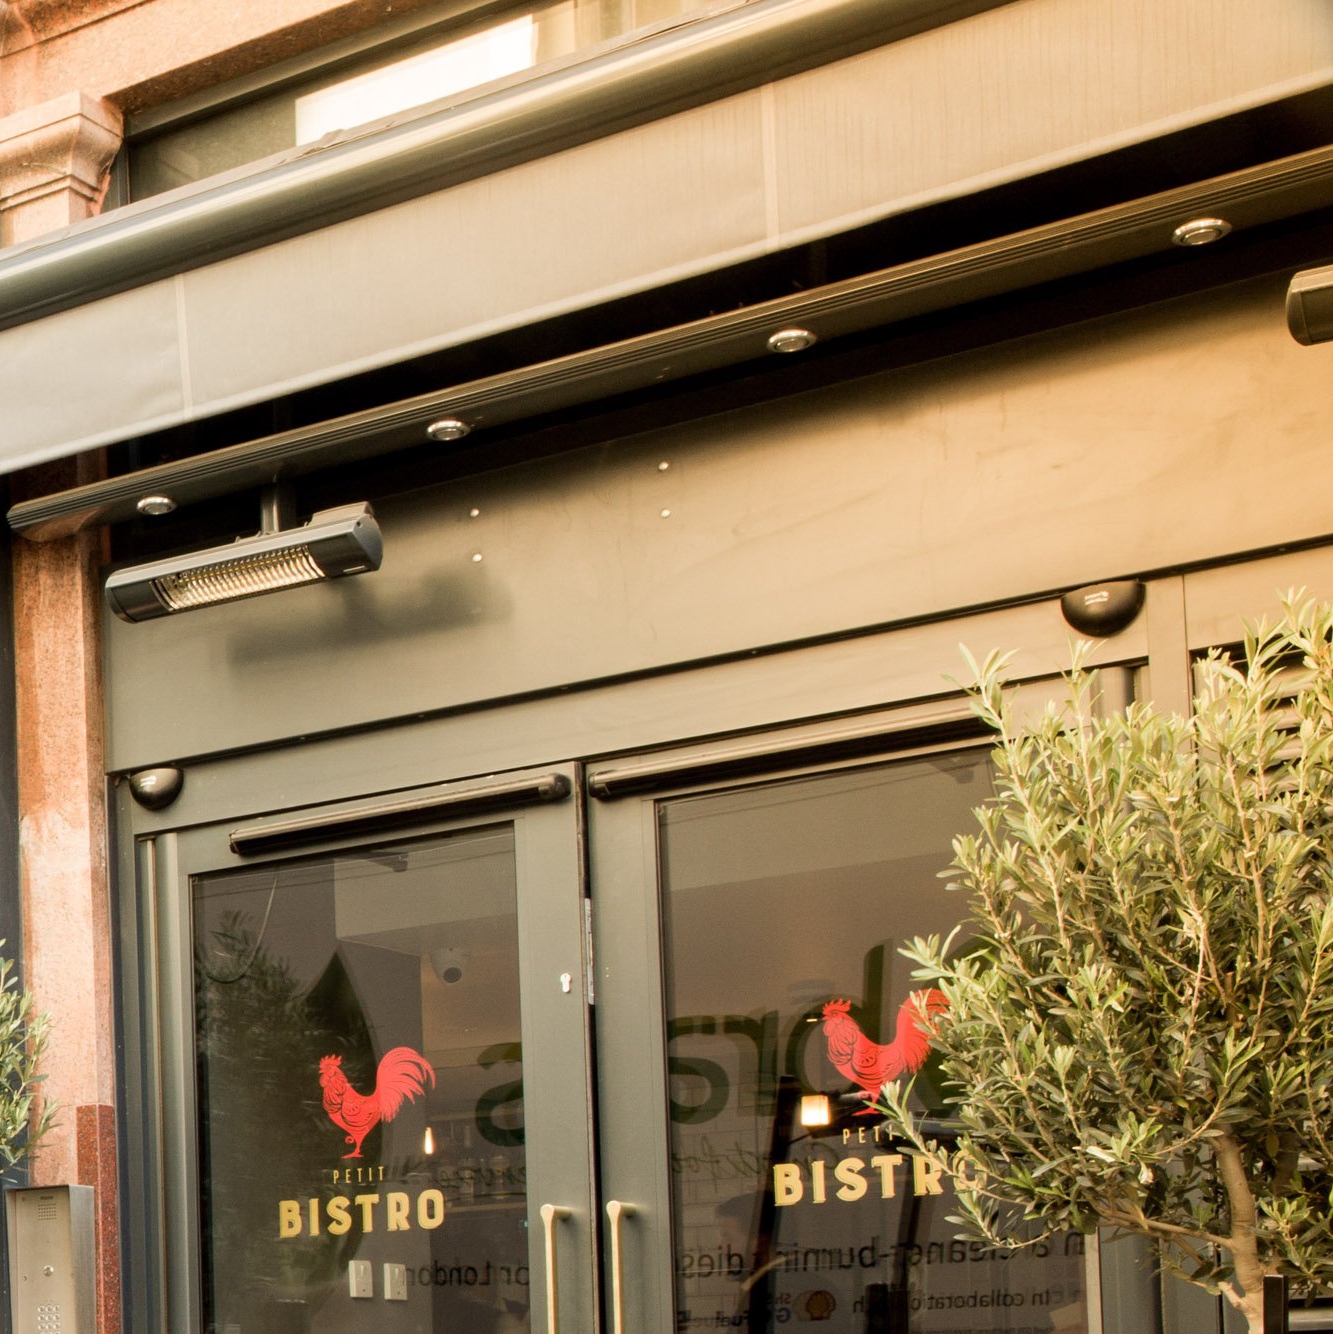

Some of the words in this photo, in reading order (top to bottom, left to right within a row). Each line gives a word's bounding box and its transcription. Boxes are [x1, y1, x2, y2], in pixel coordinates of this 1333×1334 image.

[843, 1126, 908, 1144] PETI
[333, 1166, 384, 1184] PETIT
[278, 1188, 444, 1239] BISTRO
